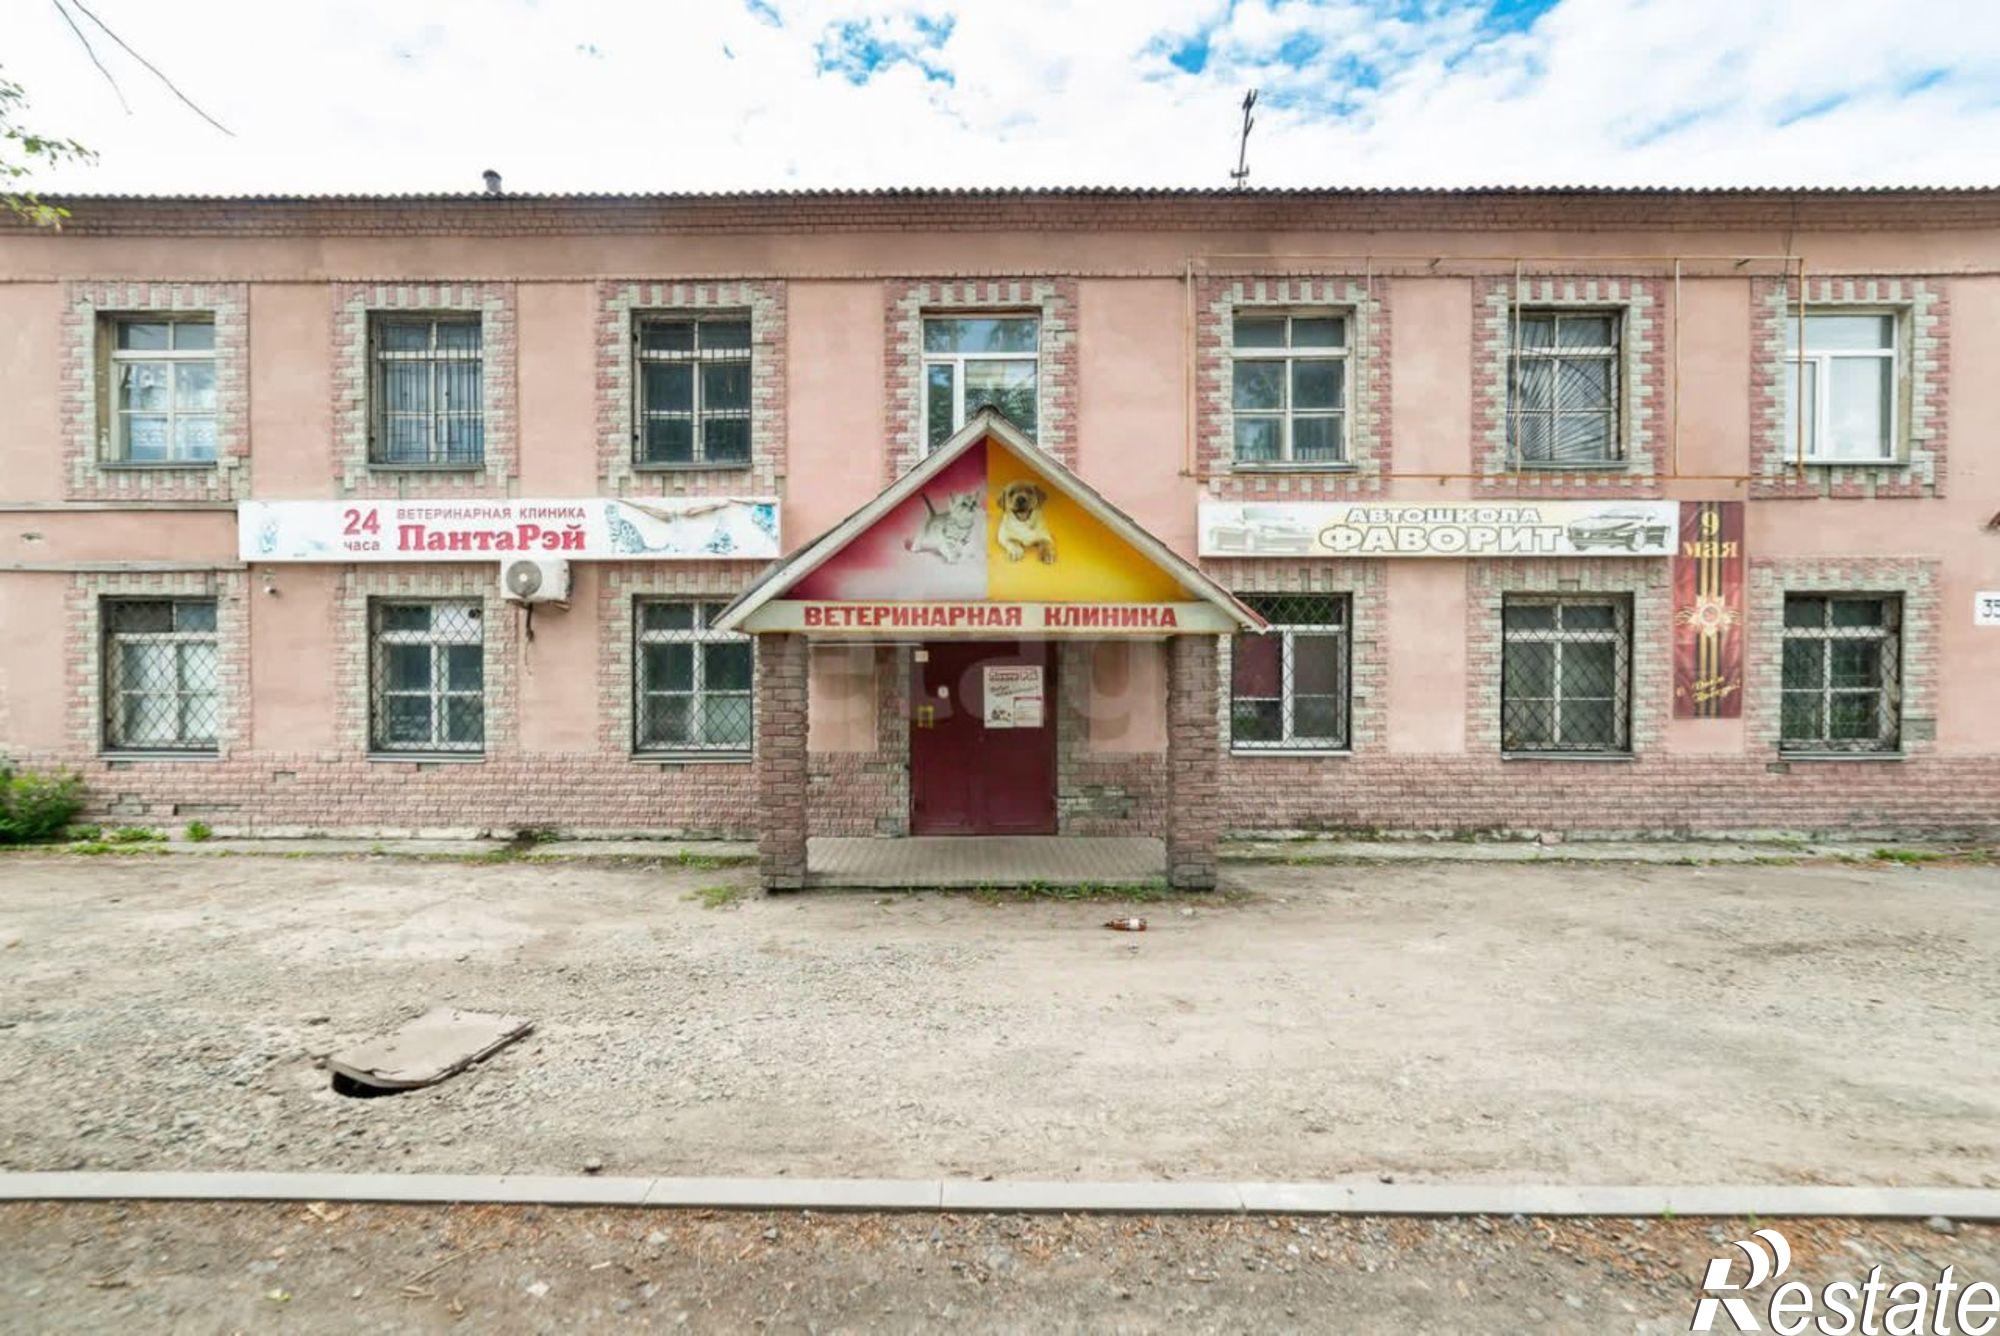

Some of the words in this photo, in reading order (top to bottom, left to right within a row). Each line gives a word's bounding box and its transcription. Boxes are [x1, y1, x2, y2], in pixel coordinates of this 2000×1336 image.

[343, 508, 380, 535] 24
[397, 507, 512, 520] ВЕТЕРИНАРНАЯ
[519, 506, 586, 519] КЛИНИКА
[1346, 507, 1542, 523] АВТОШКОЛА
[1701, 511, 1720, 536] 9
[343, 538, 380, 551] часа
[397, 523, 586, 551] ПантаРэй
[1319, 524, 1563, 552] ФАВОРИТ
[1682, 541, 1738, 558] мая
[804, 605, 1022, 627] ВЕТЕРИНАРНАЯ
[1043, 605, 1178, 627] КЛИНИКА
